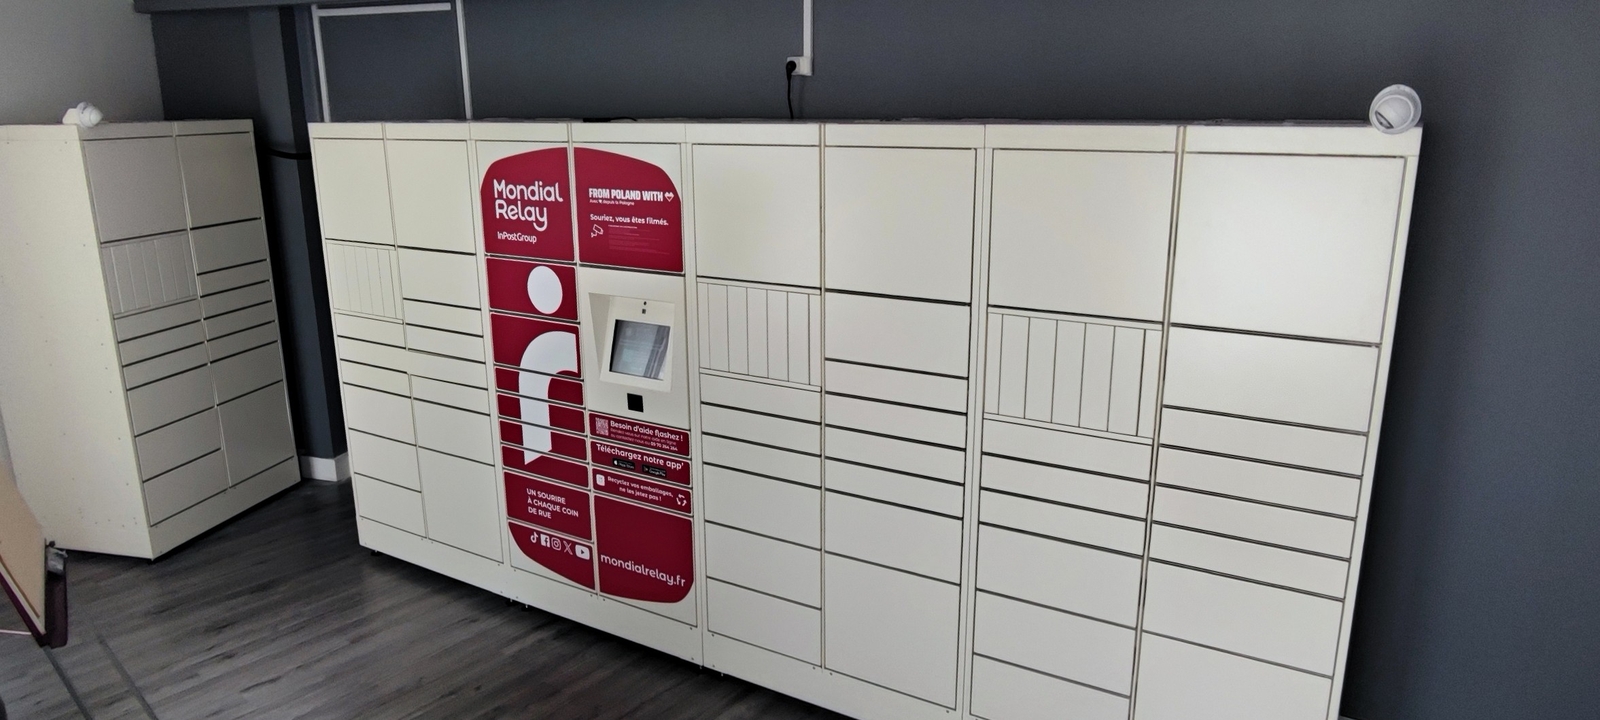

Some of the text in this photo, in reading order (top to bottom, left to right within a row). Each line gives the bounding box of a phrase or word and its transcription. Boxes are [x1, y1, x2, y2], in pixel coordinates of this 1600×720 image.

[493, 179, 564, 202] Mondial
[588, 188, 663, 202] FROM POLAND WITH
[495, 199, 548, 232] Relay
[590, 213, 615, 223] Souriez,
[631, 215, 645, 224] êtes
[646, 217, 669, 226] filmés.
[610, 420, 684, 442] Besoin d'aide flashez !
[596, 443, 642, 460] Téléchargez
[643, 455, 664, 466] notre
[666, 462, 684, 470] app'
[607, 476, 630, 487] Recyclez
[526, 488, 566, 505] UN SOURIRE
[635, 490, 649, 498] jetez
[527, 495, 579, 518] À CHAQUE COIN
[527, 506, 552, 519] DE RUE
[600, 553, 686, 588] mondialrelay.fr
